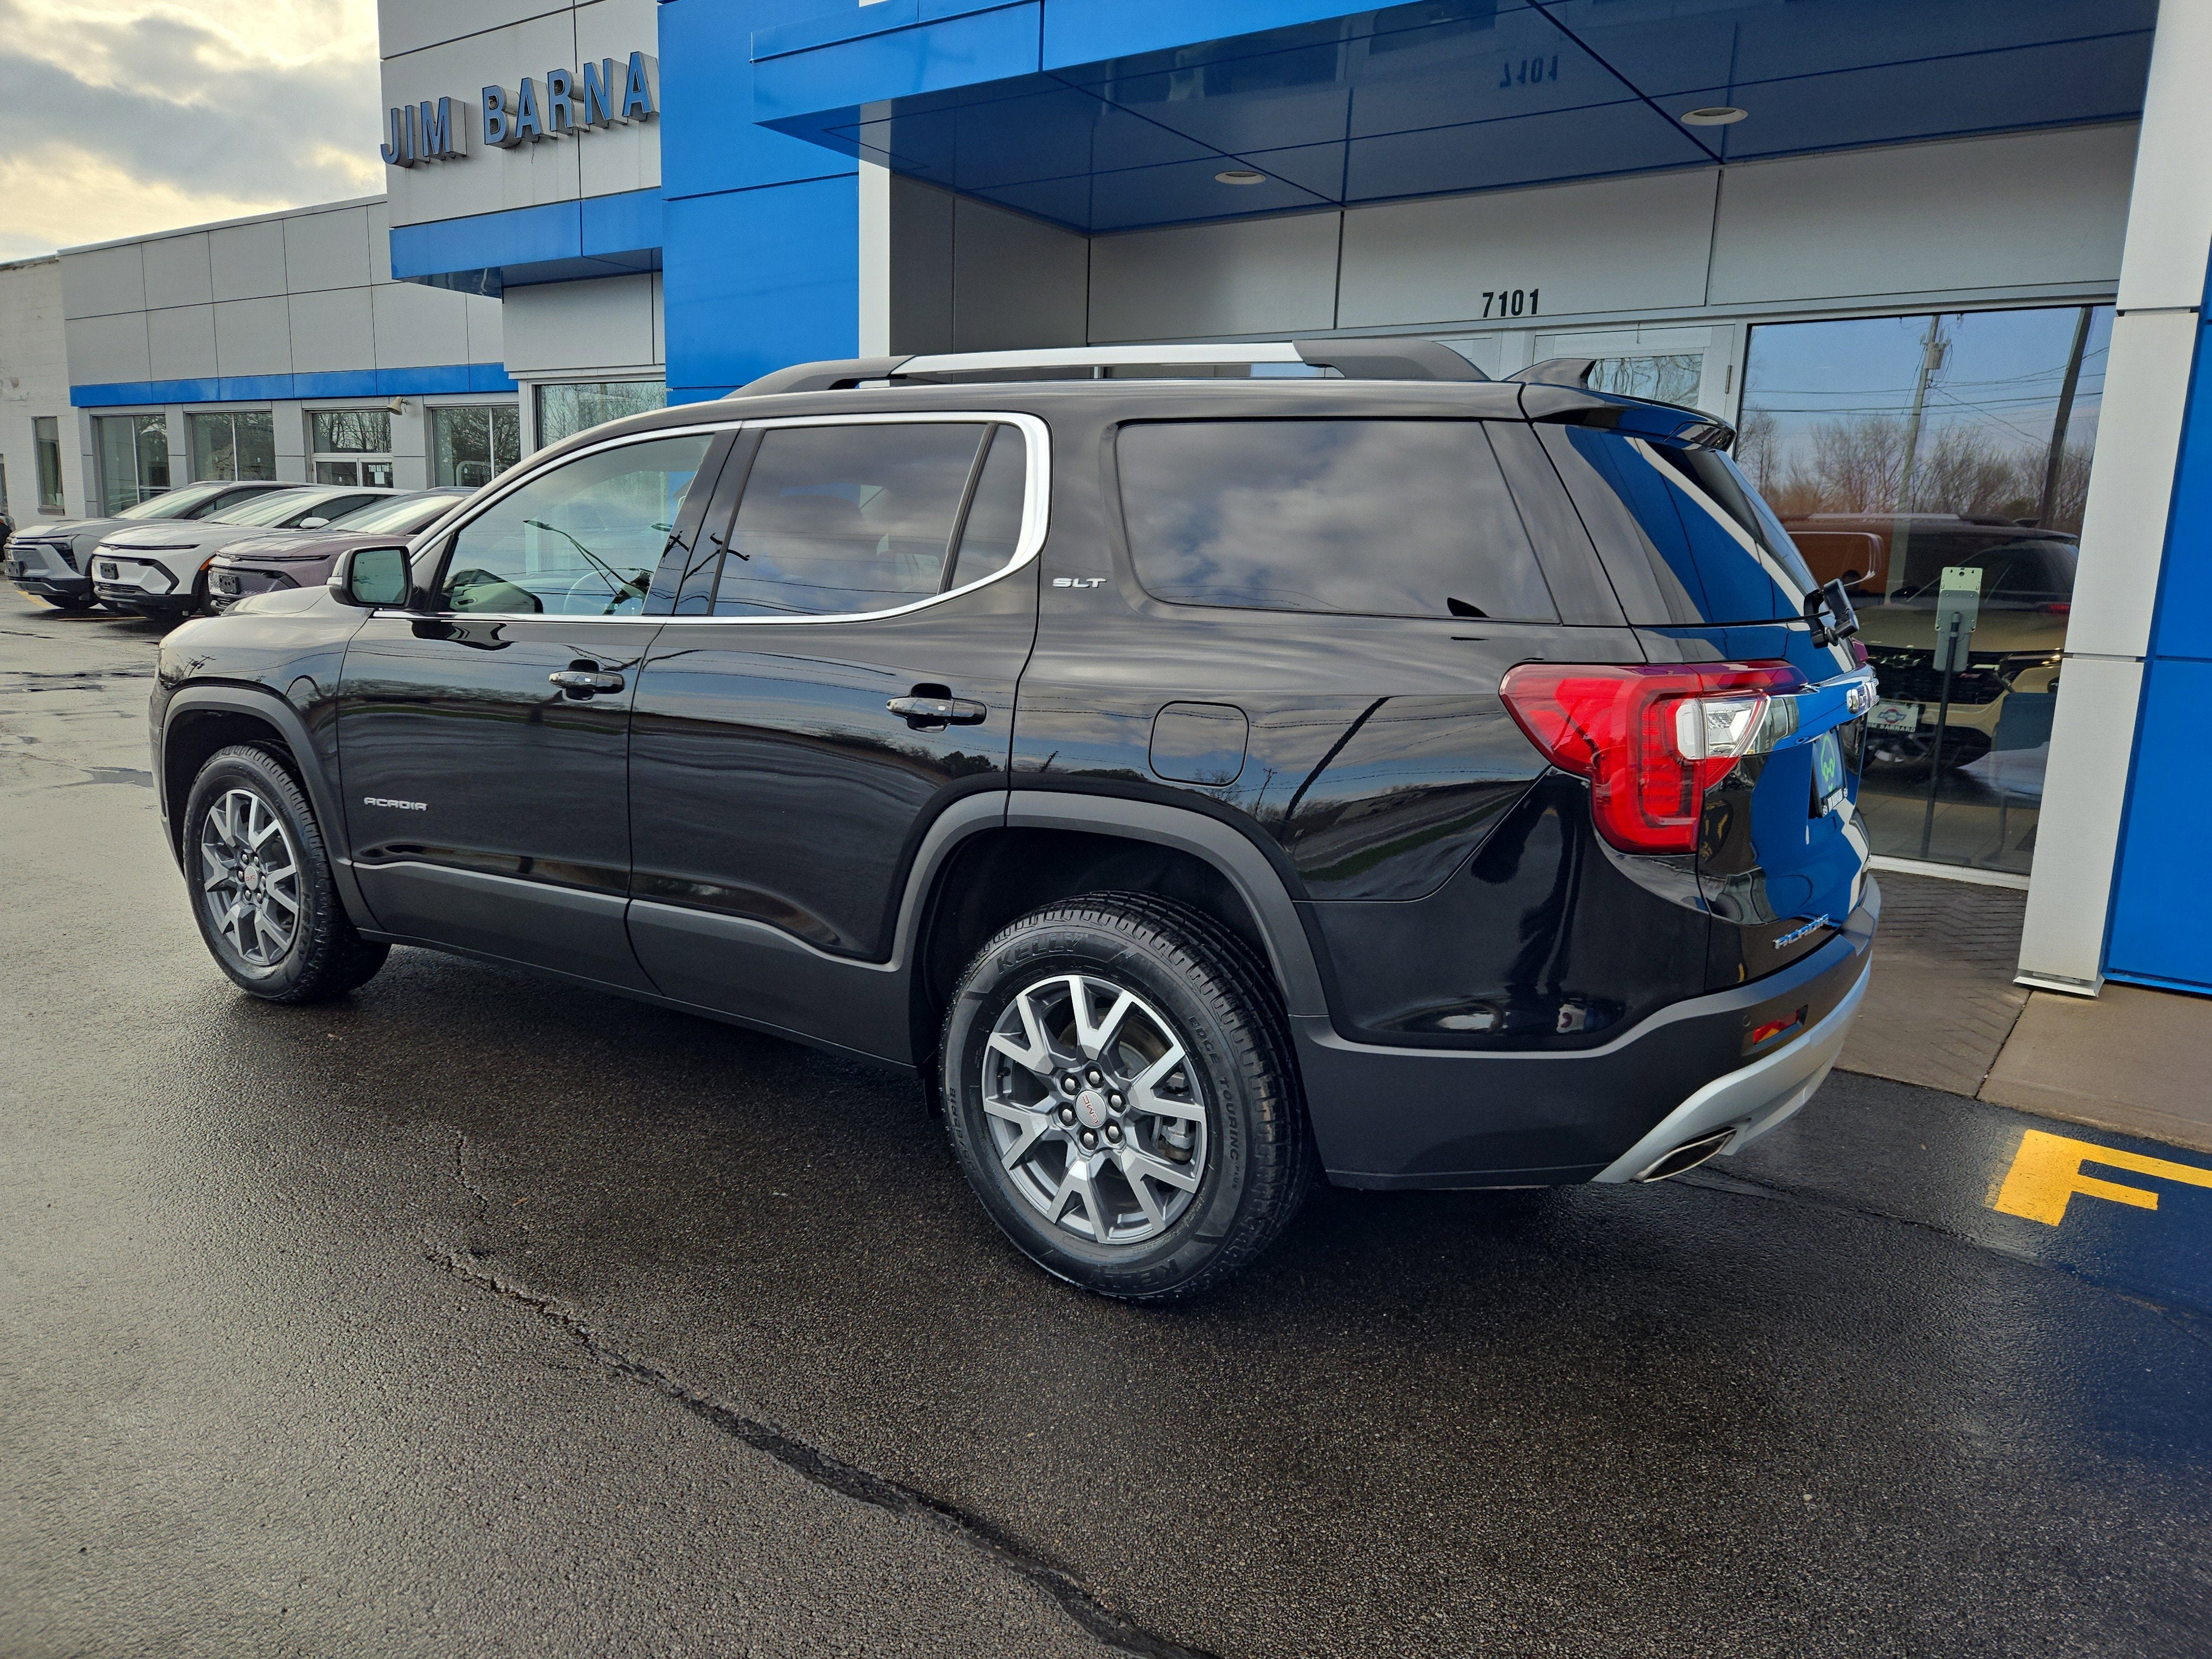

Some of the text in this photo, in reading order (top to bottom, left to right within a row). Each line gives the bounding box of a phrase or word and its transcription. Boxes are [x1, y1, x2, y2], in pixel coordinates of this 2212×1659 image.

[380, 51, 657, 167] JIM BARNA
[1482, 288, 1539, 318] 7101
[1052, 577, 1107, 588] SLT
[1880, 724, 1916, 732] BARNARD
[364, 797, 428, 811] ACADIA
[1772, 914, 1830, 949] ACADIA
[996, 933, 1084, 975] KELLY
[1082, 1094, 1099, 1124] GMC
[1188, 1015, 1240, 1189] EDGE TOURING PLUS
